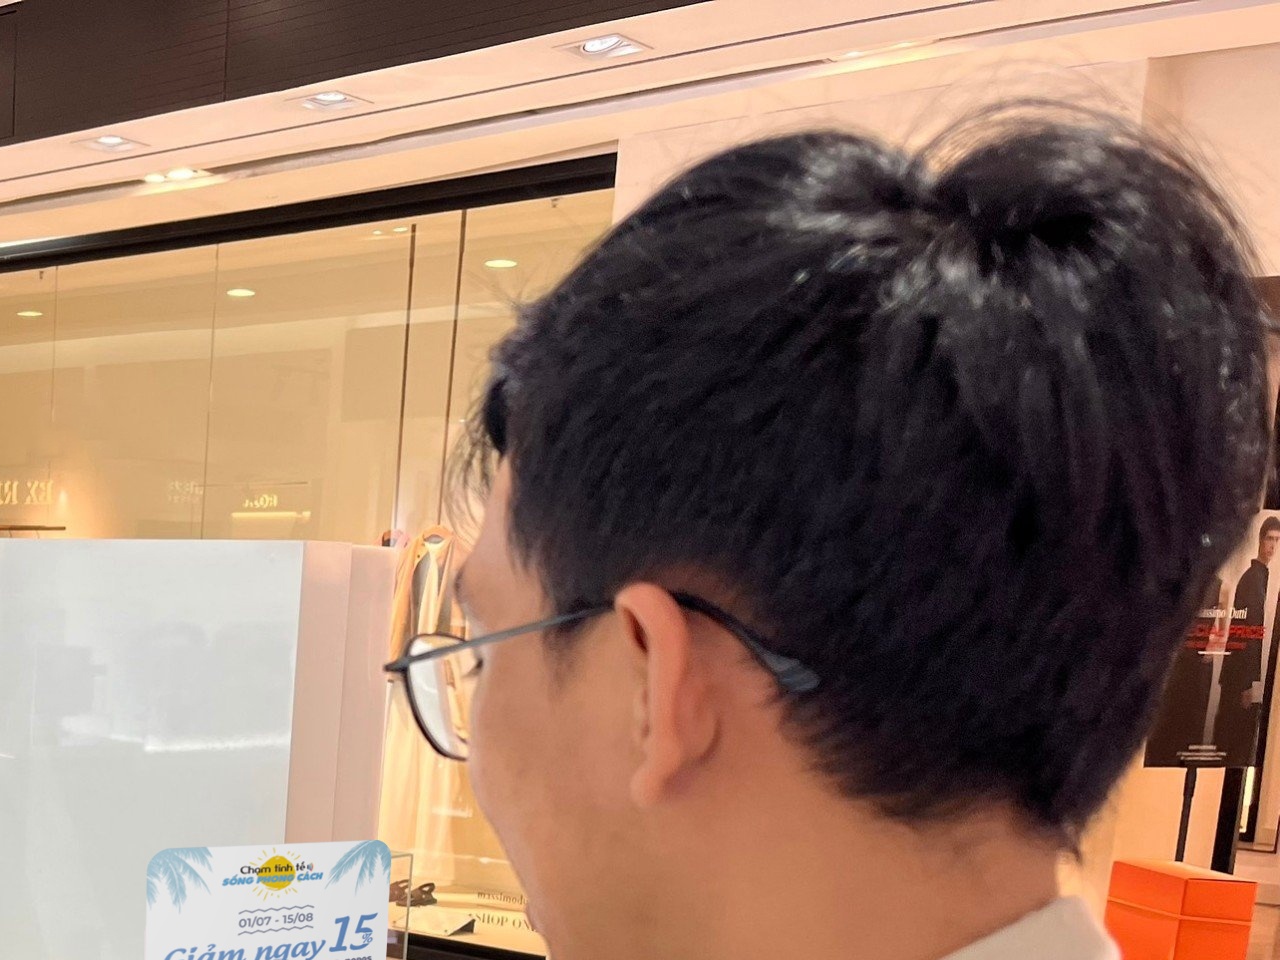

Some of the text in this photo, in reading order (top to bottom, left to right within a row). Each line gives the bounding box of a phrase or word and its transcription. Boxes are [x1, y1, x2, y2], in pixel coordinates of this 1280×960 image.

[240, 865, 271, 876] Chạm
[256, 874, 295, 884] PHONG
[297, 870, 324, 882] CÁCH
[238, 915, 272, 929] 01/07
[282, 912, 314, 926] 15/08
[475, 911, 509, 928] SHOP
